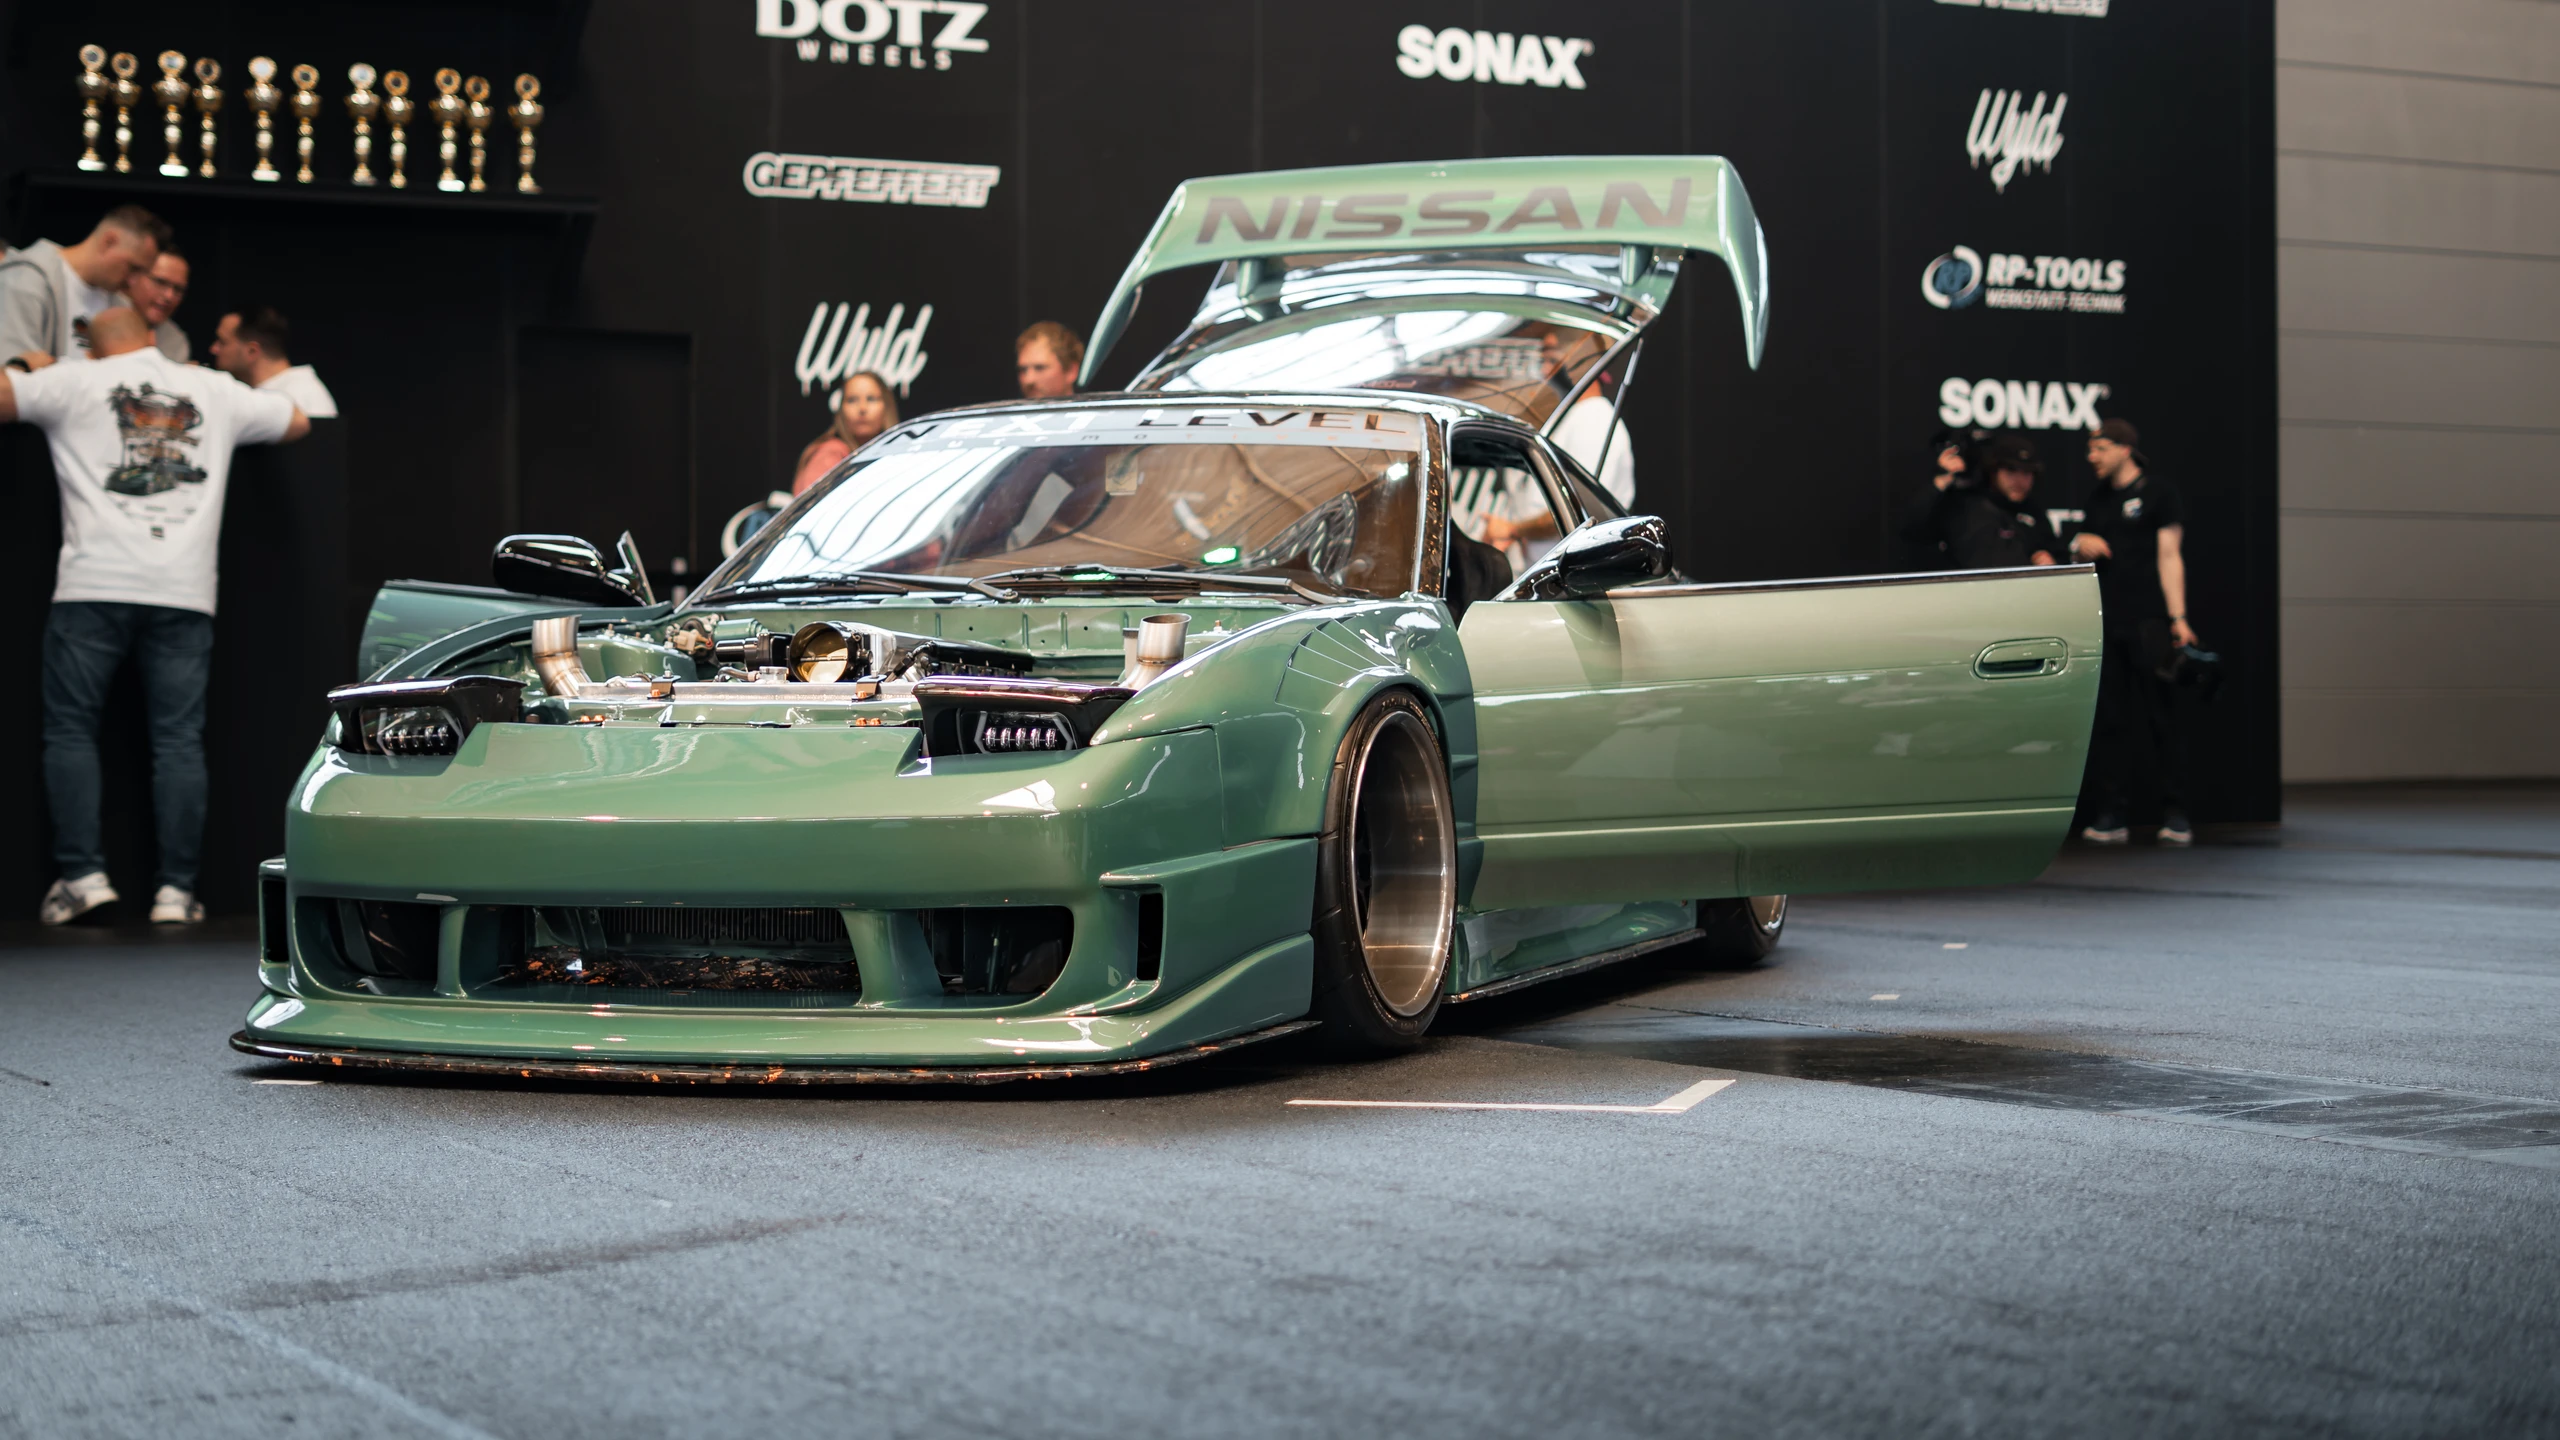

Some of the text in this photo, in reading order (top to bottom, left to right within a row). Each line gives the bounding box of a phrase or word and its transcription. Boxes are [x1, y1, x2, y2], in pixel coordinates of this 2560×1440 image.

[756, 0, 989, 52] DOTZ
[797, 39, 952, 71] WHEELS
[1396, 24, 1588, 90] SONAX
[1966, 87, 2068, 195] Wyld
[1195, 178, 1692, 244] NISSAN
[1986, 253, 2127, 292] RP-TOOLS
[883, 411, 1114, 445] NEXT
[1138, 409, 1407, 434] LEVEL
[1938, 376, 2102, 431] SONAX
